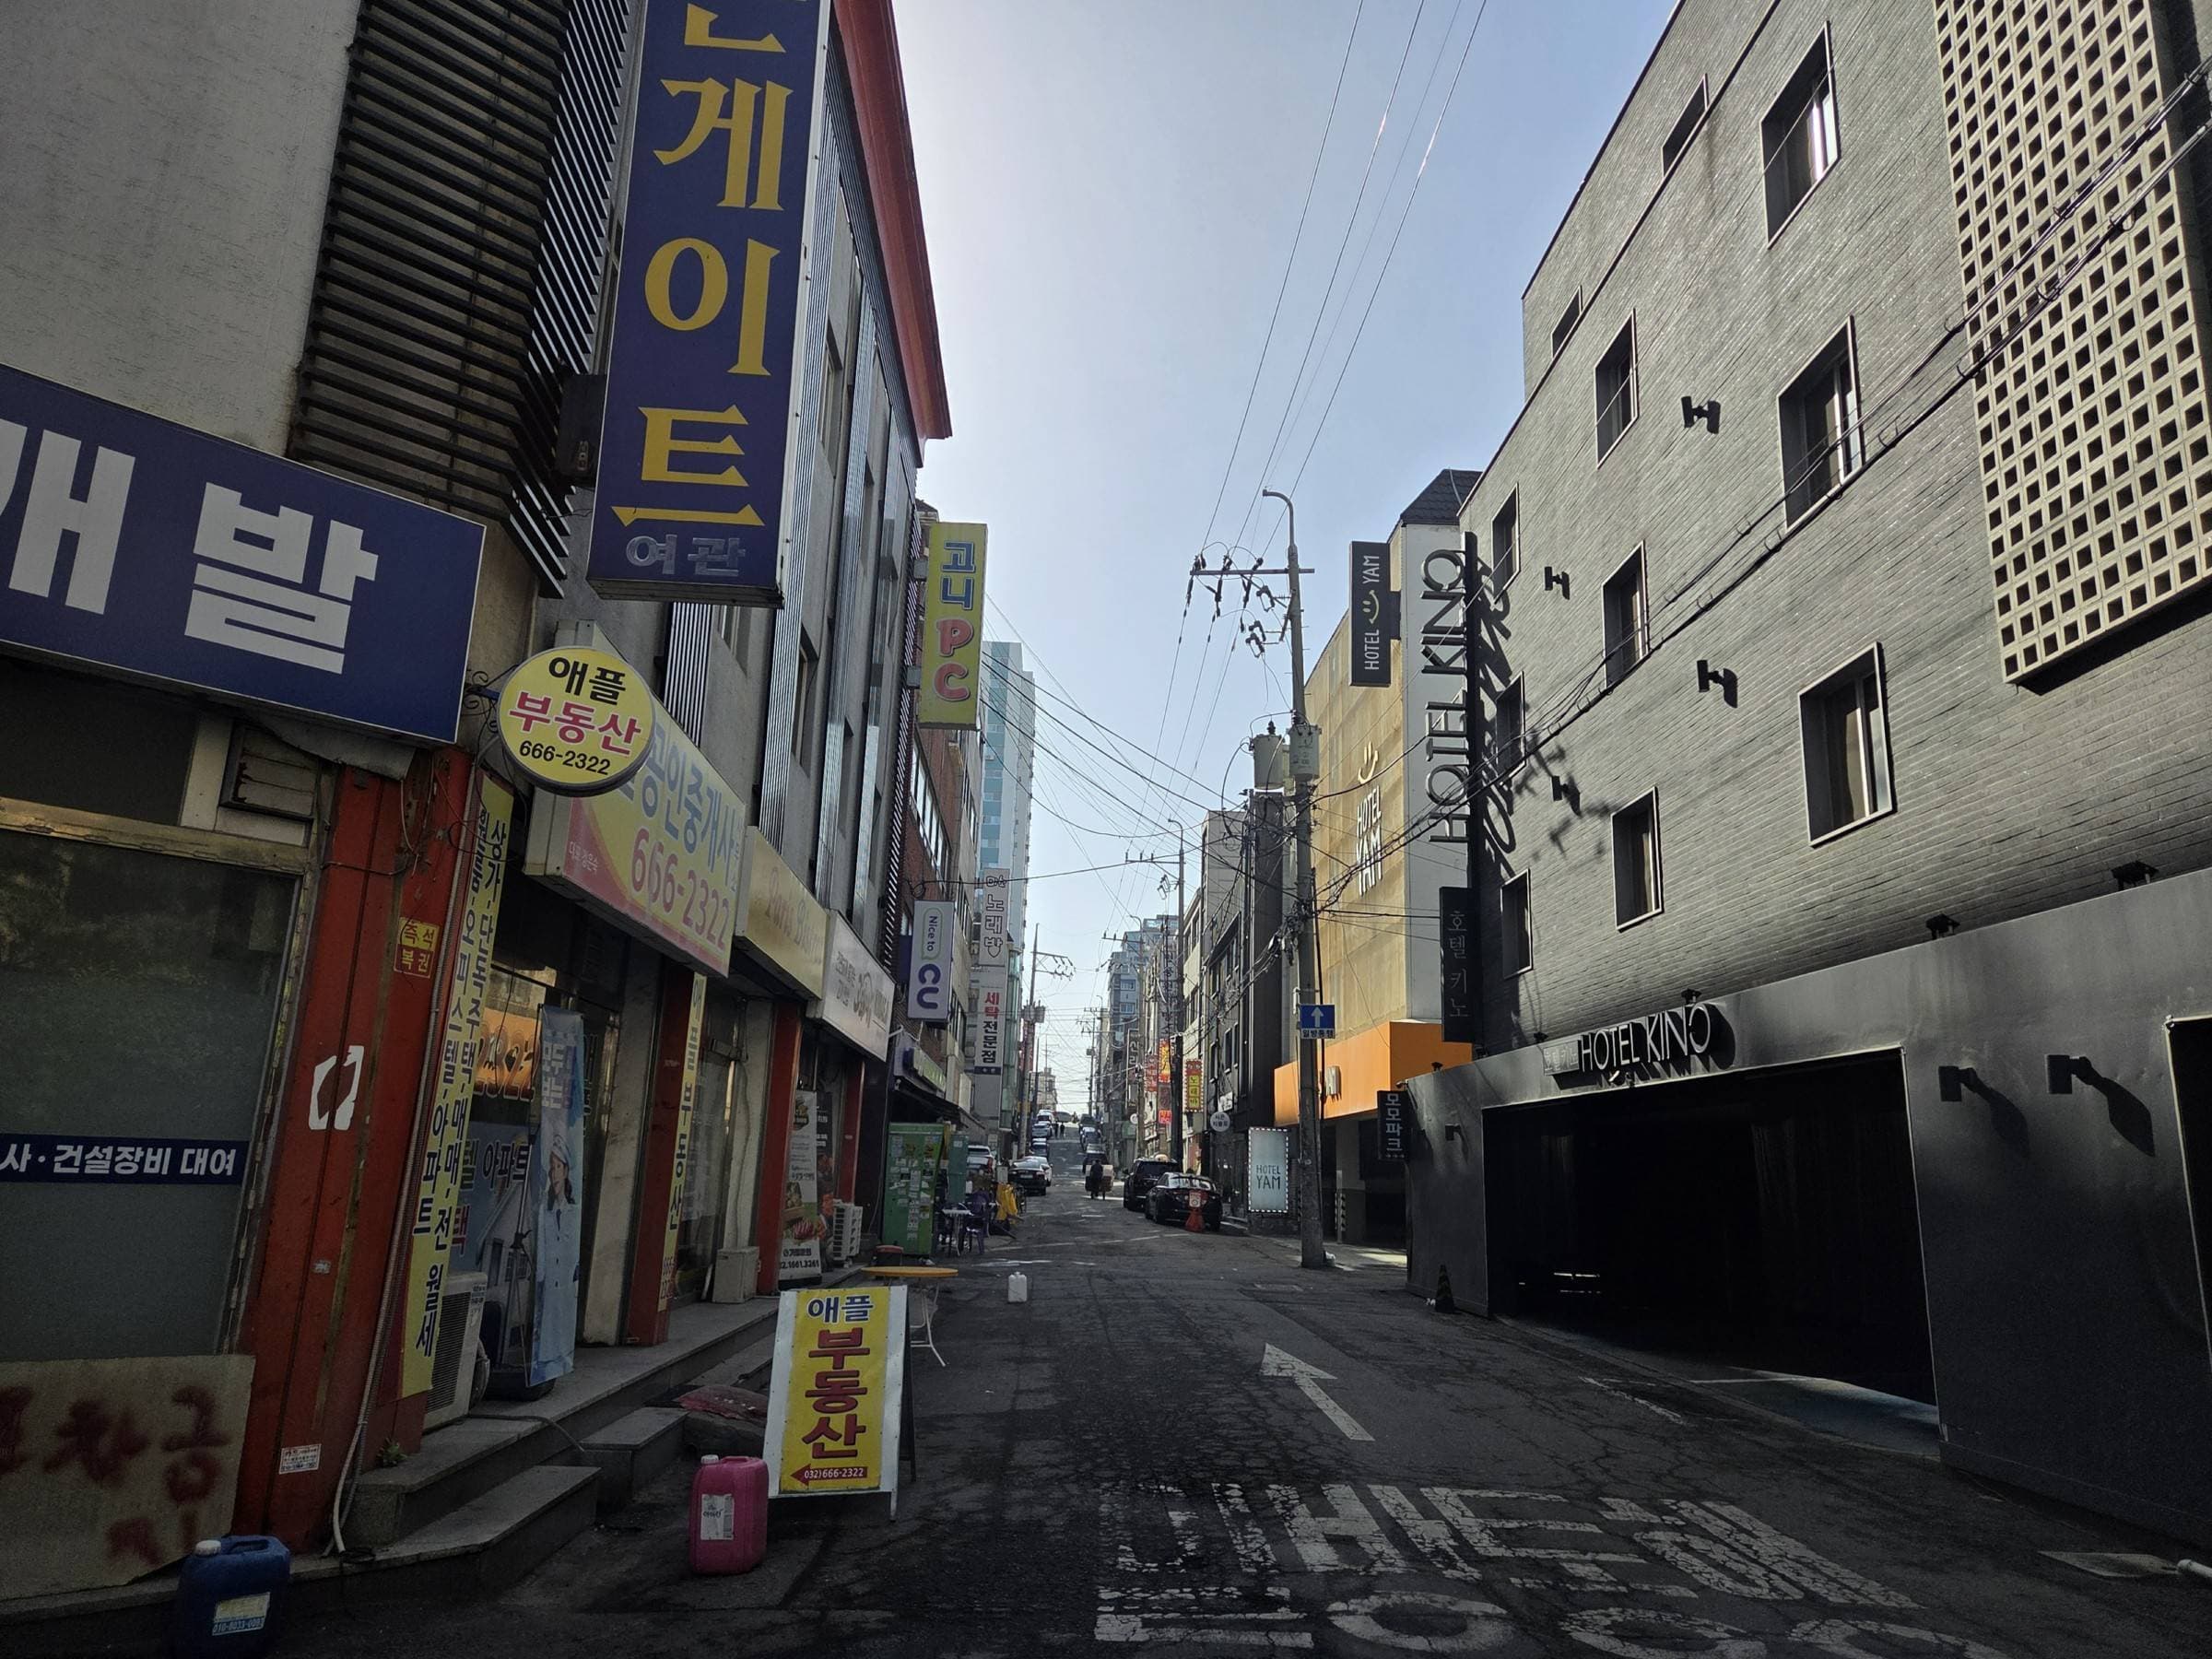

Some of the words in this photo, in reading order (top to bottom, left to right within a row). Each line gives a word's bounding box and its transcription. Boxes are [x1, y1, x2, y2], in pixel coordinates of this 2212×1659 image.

[625, 532, 747, 577] 여관
[1361, 554, 1381, 585] YAM
[1420, 548, 1468, 675] KINO
[934, 618, 974, 701] PC
[1363, 629, 1381, 671] HOTEL
[548, 656, 626, 706] 애플
[509, 690, 642, 756] 부동산
[518, 739, 612, 776] 666-2322
[1425, 700, 1470, 843] HOTEL
[1356, 785, 1382, 838] HOTEL
[1356, 825, 1382, 896] YAM
[631, 827, 730, 951] 666-2322
[926, 940, 935, 952] to
[927, 915, 938, 938] Nice
[984, 893, 1005, 959] 노래방
[1448, 910, 1468, 959] 호텔
[399, 947, 432, 974] 복권
[916, 963, 942, 1010] CU
[1449, 968, 1469, 1018] 키노
[1581, 1023, 1641, 1072] HOTEL
[1645, 1001, 1712, 1064] KINO
[1385, 1093, 1403, 1151] 모모파크
[179, 1147, 237, 1176] 대여
[482, 1138, 532, 1191] 아파트
[1256, 1164, 1281, 1175] HOTEL
[1256, 1175, 1281, 1191] YAM
[806, 1294, 875, 1324] 애플
[802, 1327, 870, 1460] 부동산
